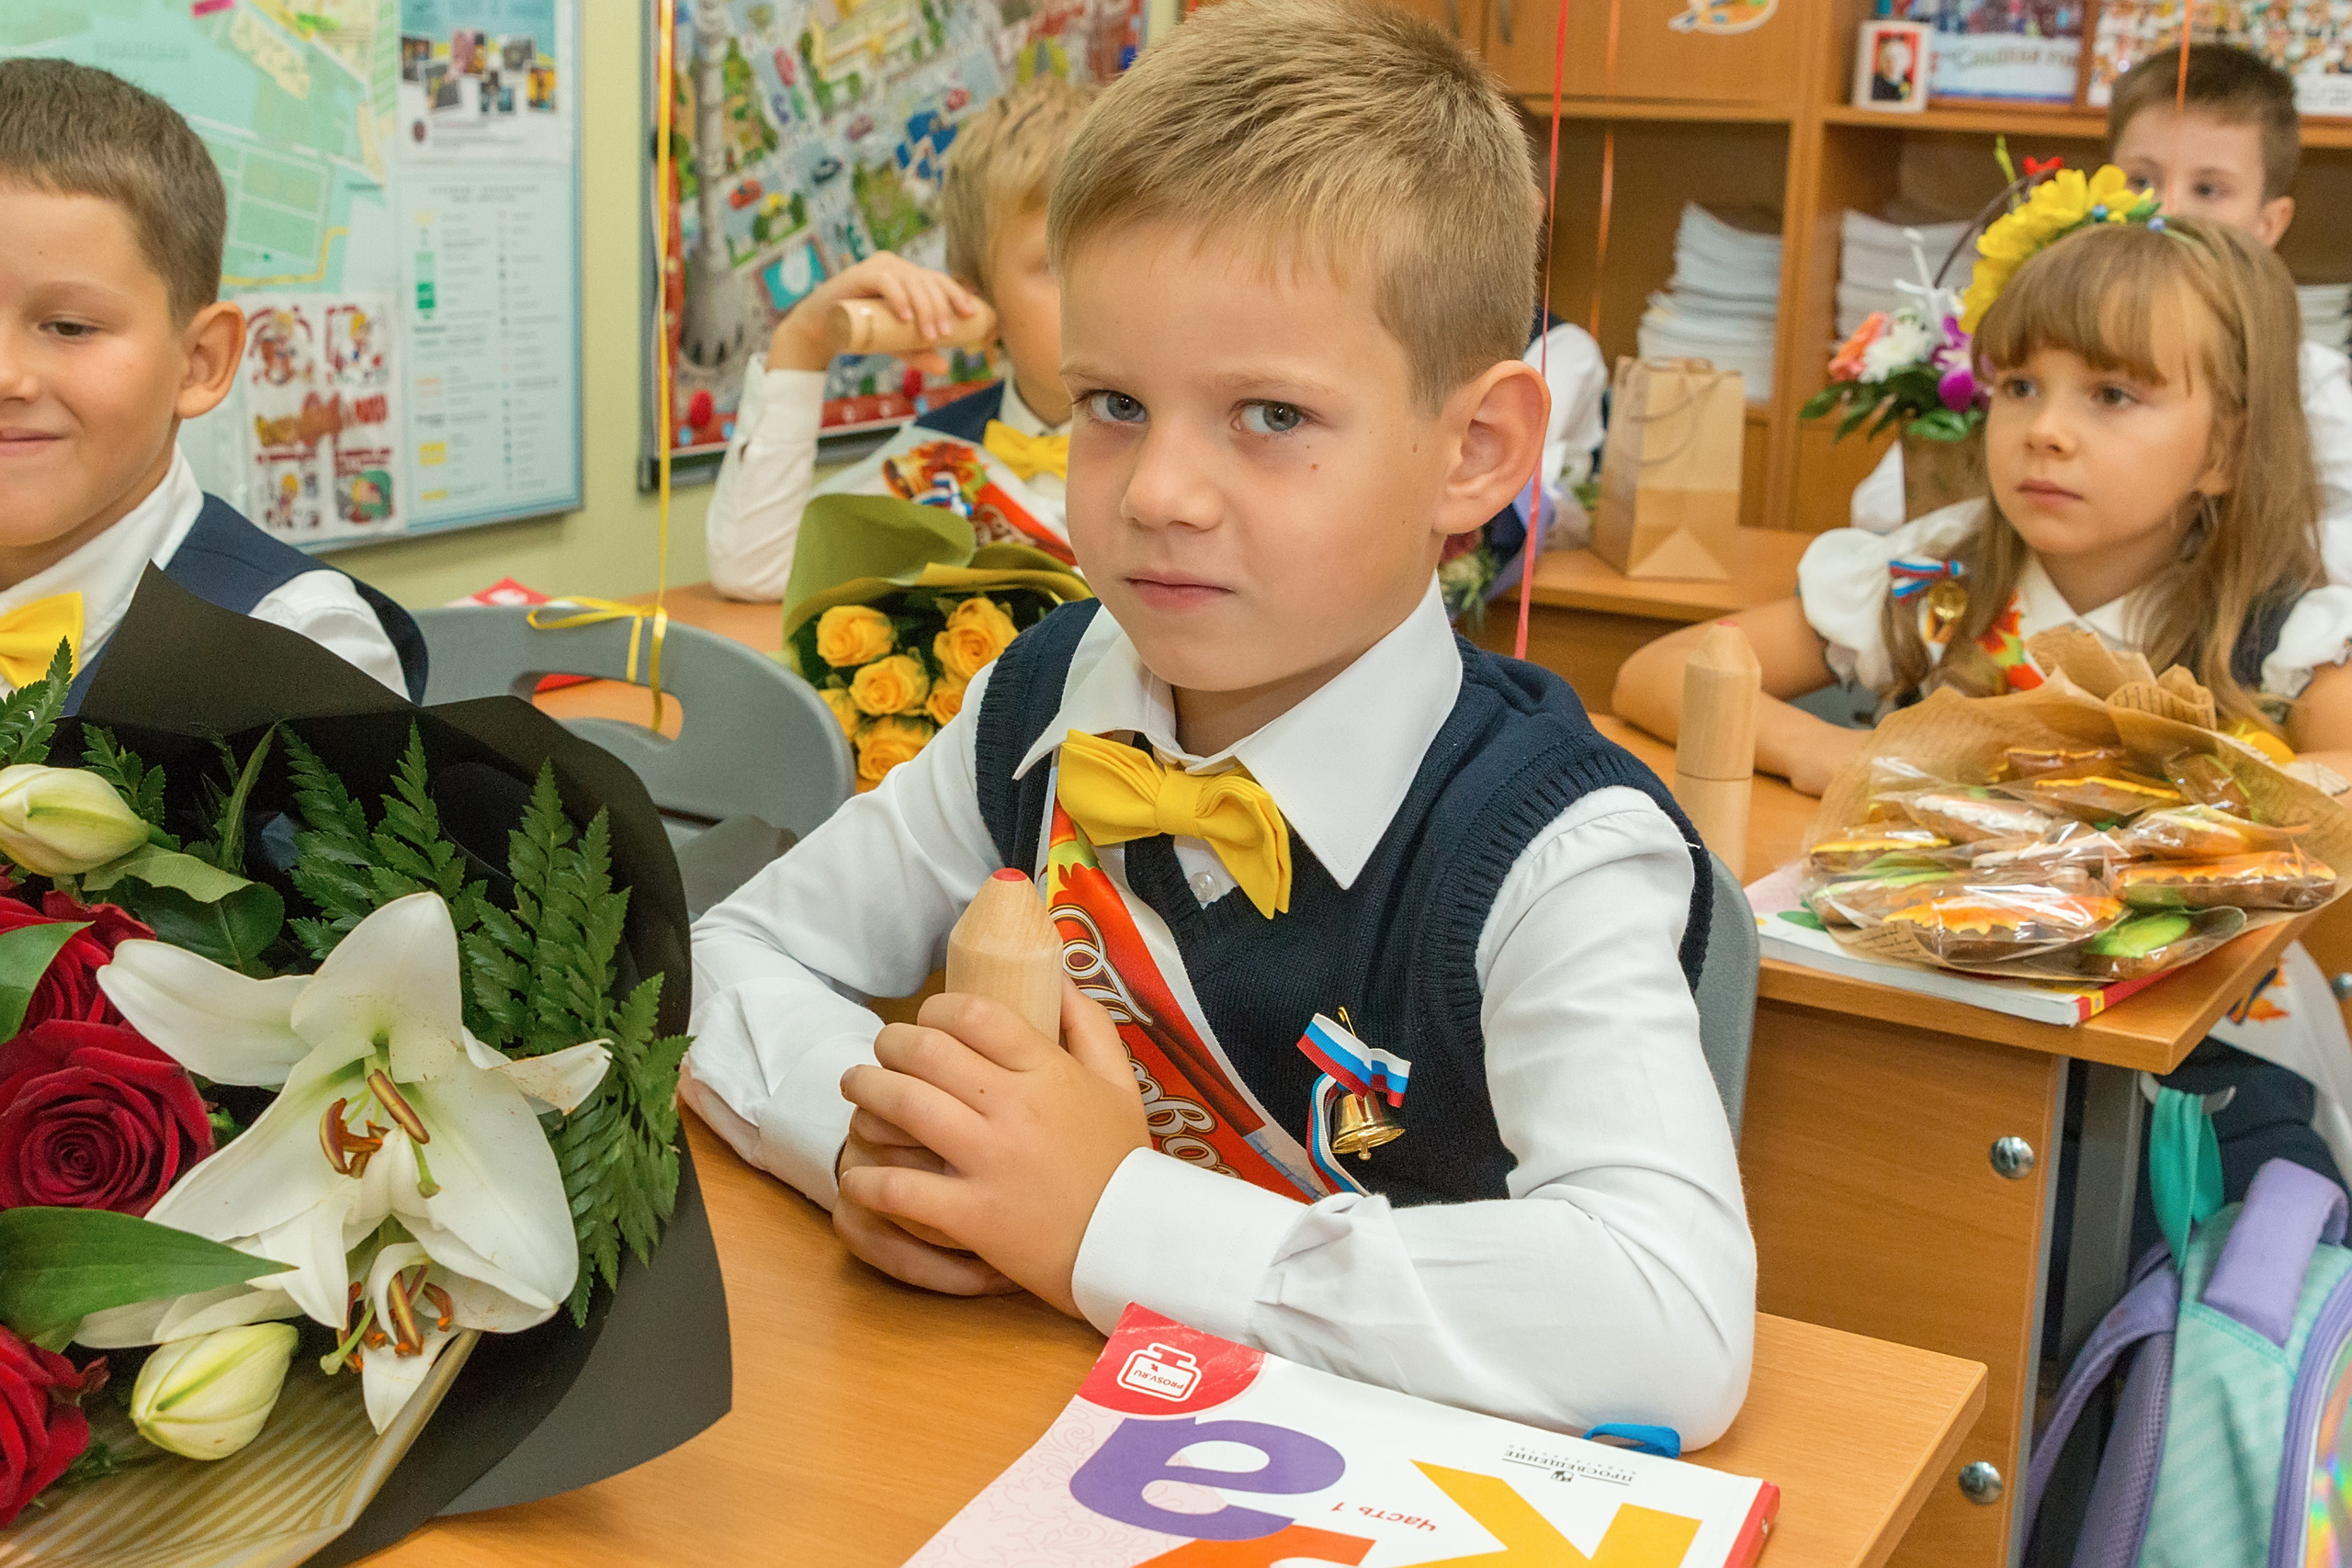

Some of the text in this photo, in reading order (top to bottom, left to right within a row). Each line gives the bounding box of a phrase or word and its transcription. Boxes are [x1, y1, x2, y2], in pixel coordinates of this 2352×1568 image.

[1133, 1370, 1184, 1390] PROSV.RU
[1504, 1450, 1634, 1482] ПРОСВЕЩЕНИЕ
[1330, 1501, 1344, 1513] 1
